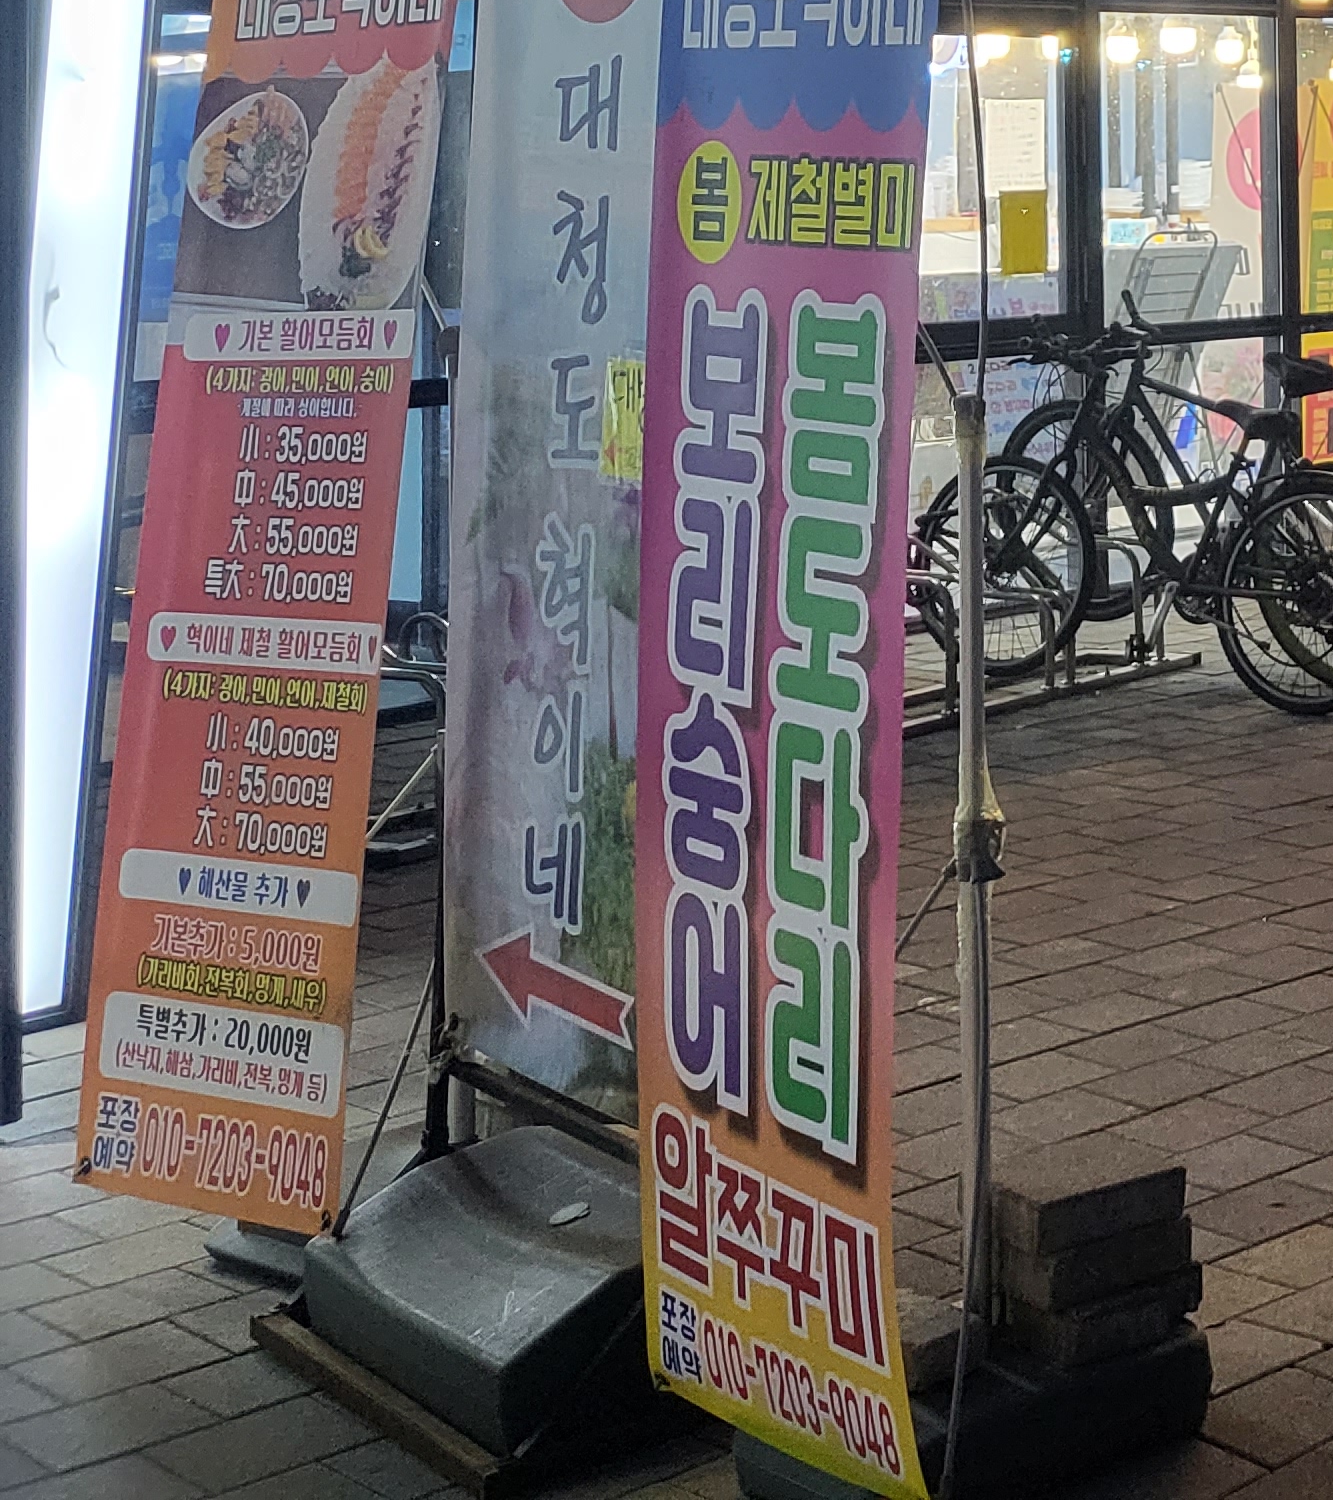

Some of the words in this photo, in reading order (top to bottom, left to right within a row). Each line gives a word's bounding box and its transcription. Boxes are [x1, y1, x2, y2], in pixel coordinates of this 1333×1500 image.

[691, 156, 728, 242] 봄
[747, 155, 915, 249] 제철별미
[238, 320, 273, 352] 기본
[280, 317, 374, 352] 활어모듬회
[239, 424, 260, 463] 小
[275, 425, 368, 464] 35,000원
[233, 468, 255, 507] 中
[271, 471, 364, 510] 45,000원
[228, 514, 248, 554] 大
[265, 517, 359, 556] 55,000원
[204, 559, 245, 600] 특大
[262, 563, 353, 604] 70,000원
[186, 623, 235, 657] 혁이네
[238, 626, 270, 659] 제철
[277, 628, 362, 665] 활어모듬회
[206, 712, 228, 753] 小
[243, 716, 340, 762] 40,000원
[772, 304, 879, 1145] 봄도다리
[200, 757, 223, 798] 中
[238, 761, 333, 810] 55,000원
[193, 804, 217, 847] 大
[234, 811, 328, 859] 70,000원
[198, 865, 248, 903] 해산물
[253, 871, 290, 909] 추가
[151, 913, 226, 961] 기본추가
[240, 926, 323, 975] 5,000원
[135, 1002, 207, 1047] 특별추가
[224, 1017, 313, 1064] 20,000원
[306, 1073, 328, 1105] 등)
[96, 1095, 140, 1134] 포장
[92, 1133, 137, 1174] 예약
[139, 1106, 328, 1211] 010-7203-9048
[655, 1111, 886, 1368] 알쭈꾸미
[661, 1290, 697, 1343] 포장
[662, 1336, 701, 1384] 예약
[703, 1319, 901, 1476] 010-7203-9048
